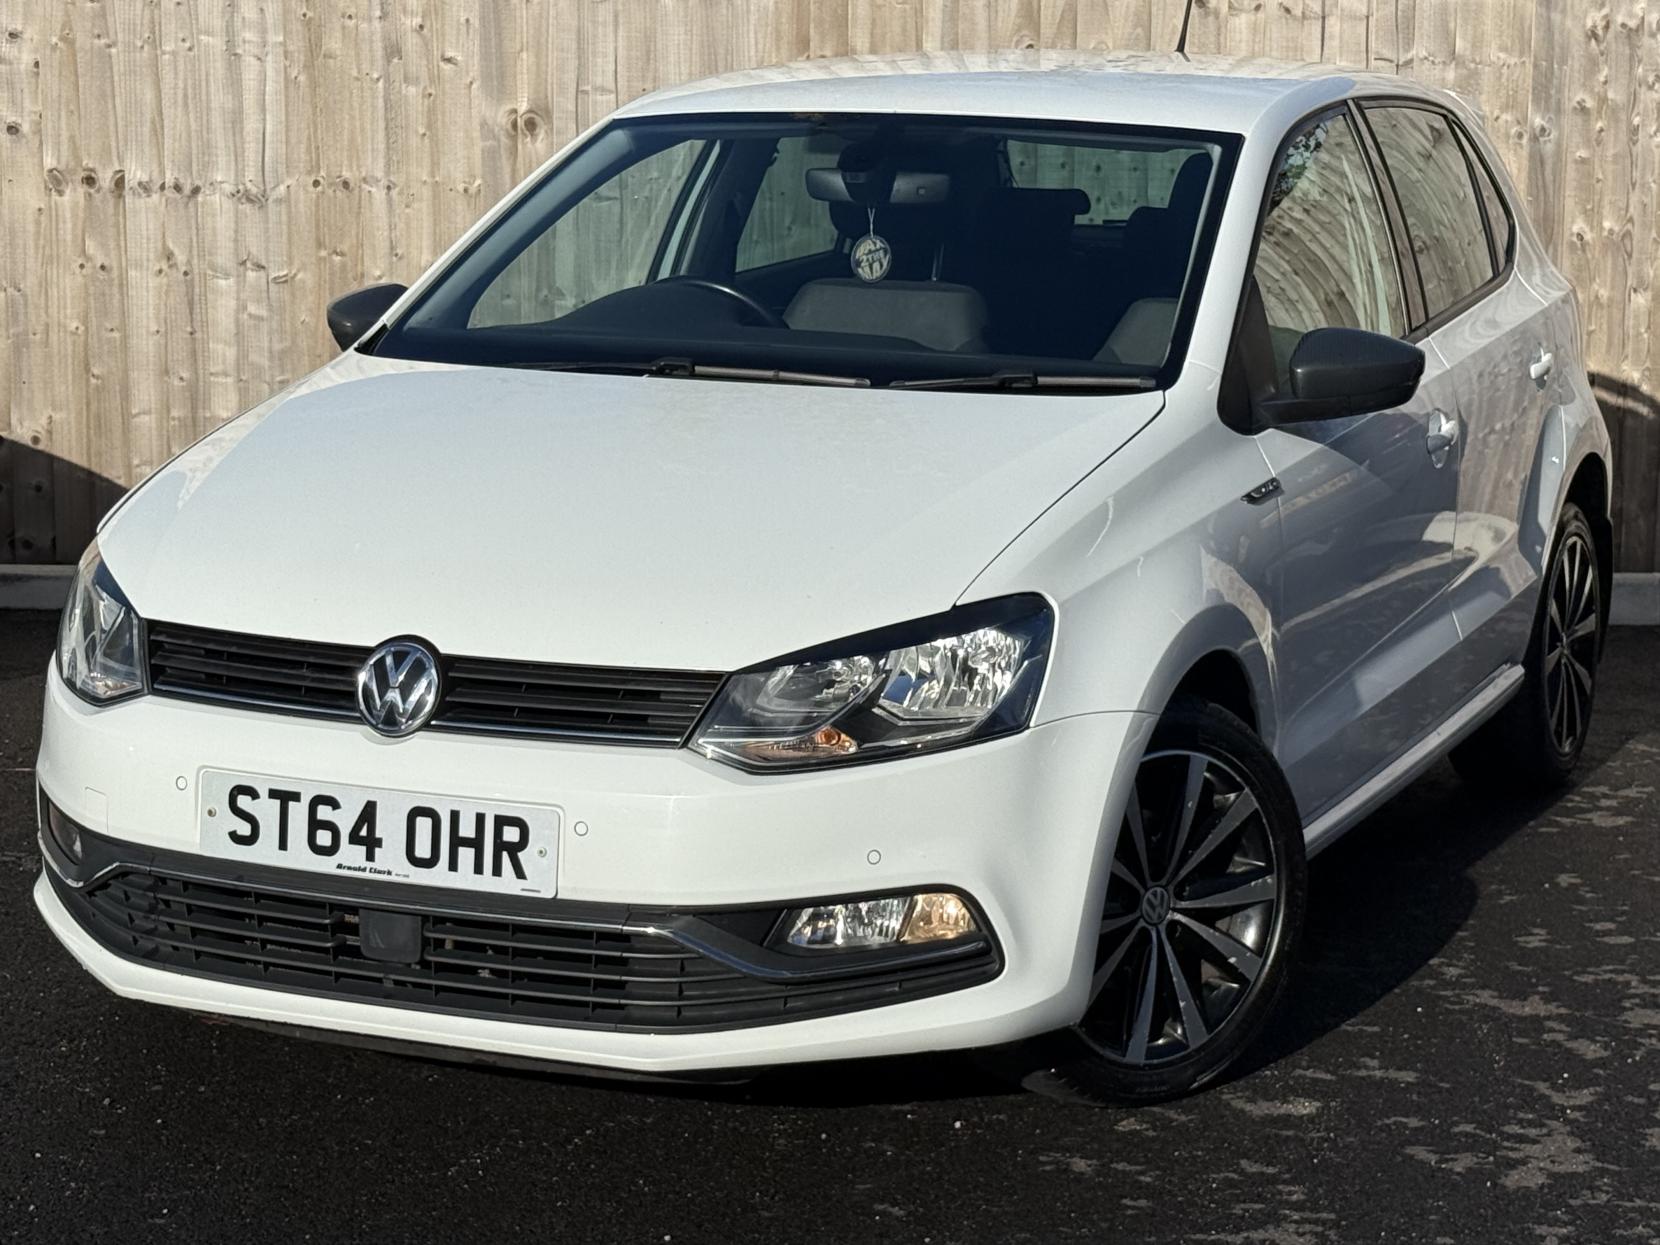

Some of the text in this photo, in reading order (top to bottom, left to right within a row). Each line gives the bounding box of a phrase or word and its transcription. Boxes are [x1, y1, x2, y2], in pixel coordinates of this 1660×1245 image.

[227, 784, 530, 881] ST64 OHR
[336, 863, 367, 873] Arnold
[369, 867, 393, 877] Clark
